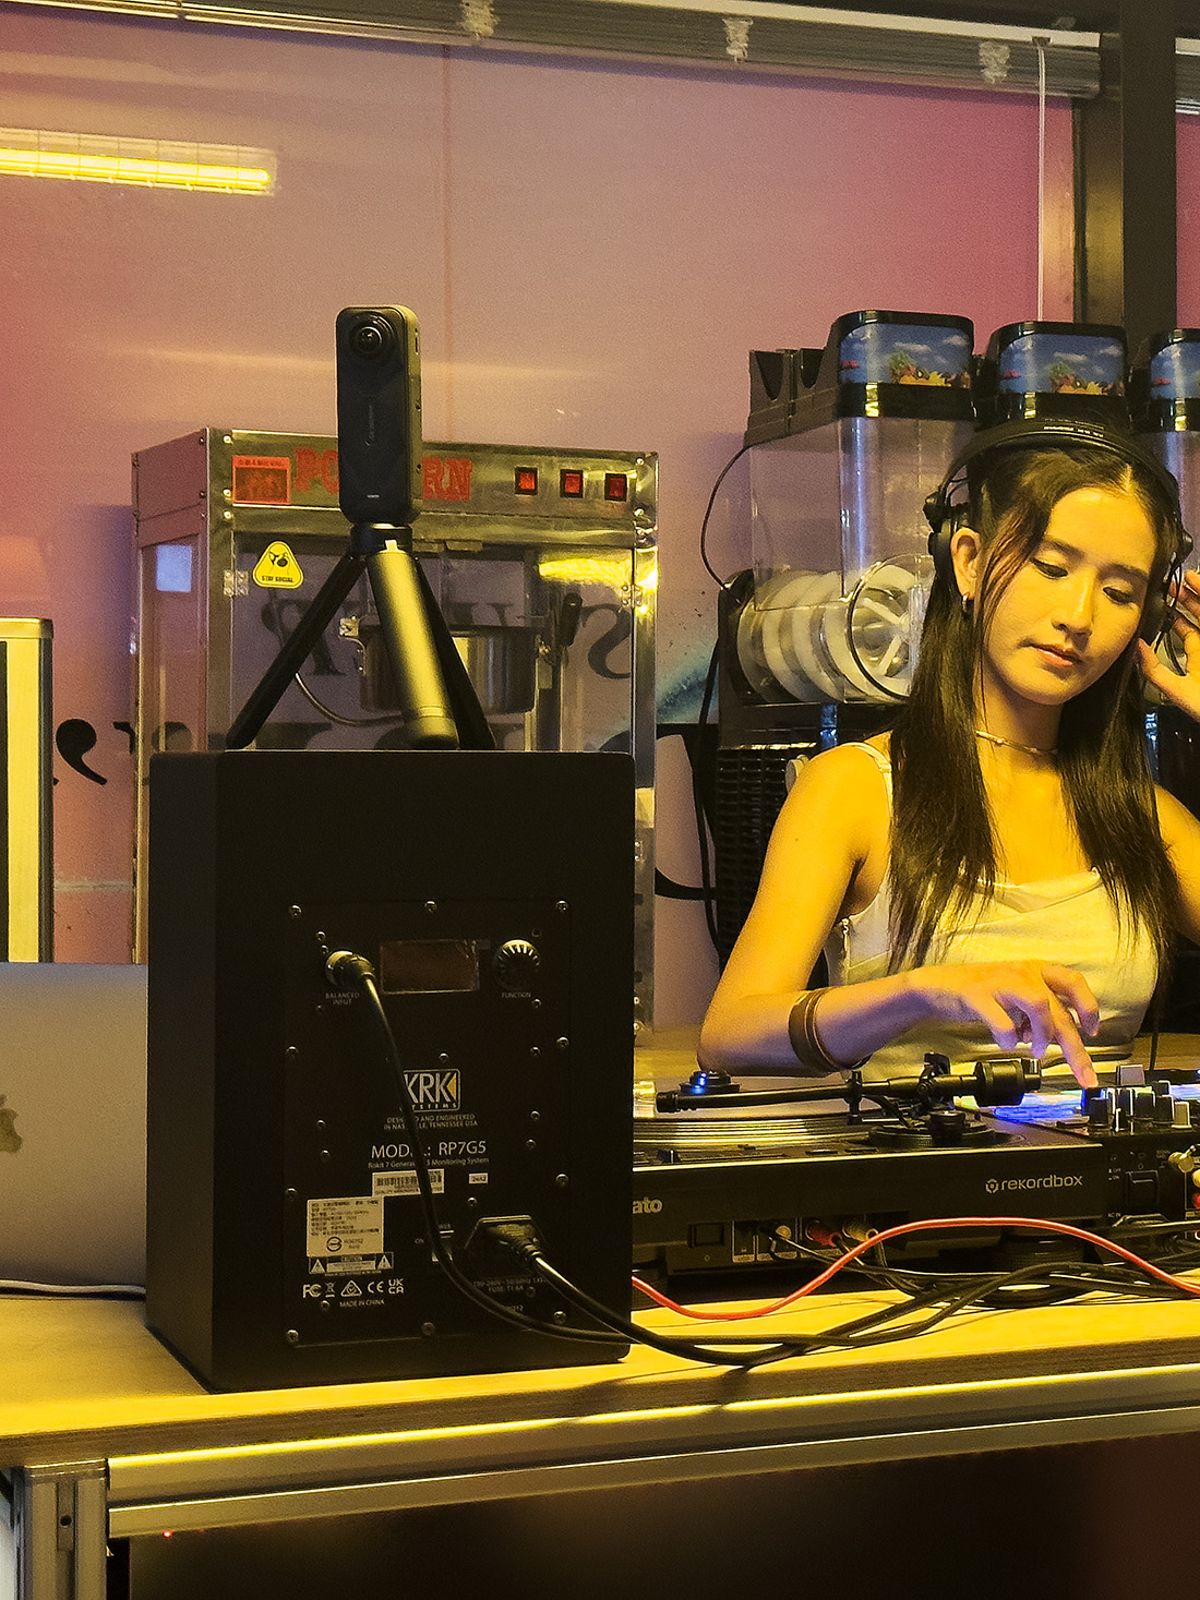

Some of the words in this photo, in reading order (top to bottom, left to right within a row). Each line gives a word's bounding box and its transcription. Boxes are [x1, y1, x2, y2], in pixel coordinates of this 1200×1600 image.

[294, 447, 473, 501] PORN
[371, 1143, 431, 1159] MOD:
[438, 1140, 488, 1157] RP7G5
[1000, 1173, 1084, 1192] rekordbox
[632, 1196, 663, 1215] ato
